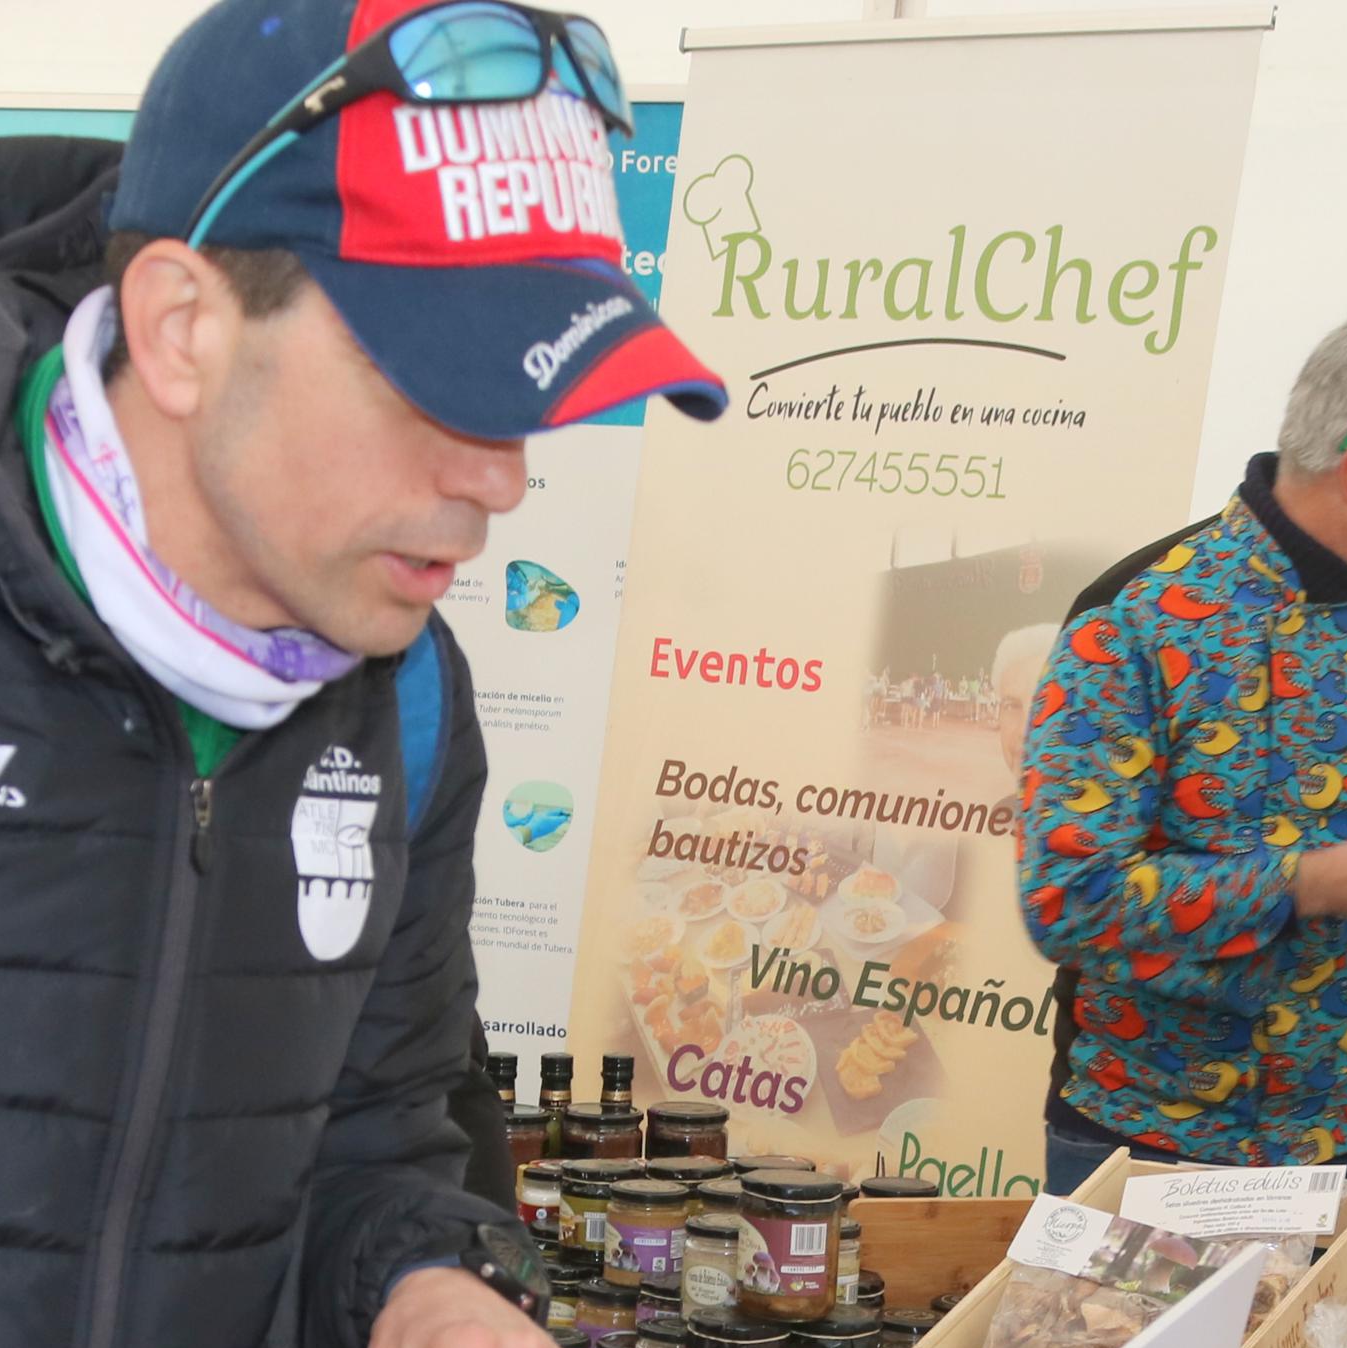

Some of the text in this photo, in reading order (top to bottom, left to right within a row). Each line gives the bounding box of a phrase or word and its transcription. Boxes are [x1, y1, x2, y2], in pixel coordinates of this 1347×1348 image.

[712, 225, 1218, 355] RuralChef
[746, 381, 1088, 435] Convierte tu pueblo en una cocina
[786, 448, 1007, 500] 627455551
[650, 637, 824, 693] Eventos
[507, 691, 519, 701] de
[520, 692, 552, 703] micelio
[655, 759, 1019, 840] Bodas, comunione
[646, 819, 809, 878] bautizos
[495, 897, 525, 909] Tubera
[528, 901, 548, 912] para
[750, 943, 1053, 1037] Vino Español
[483, 1020, 567, 1039] sarrollado
[666, 1043, 808, 1115] Catas
[1160, 1169, 1303, 1201] Boletus edulis
